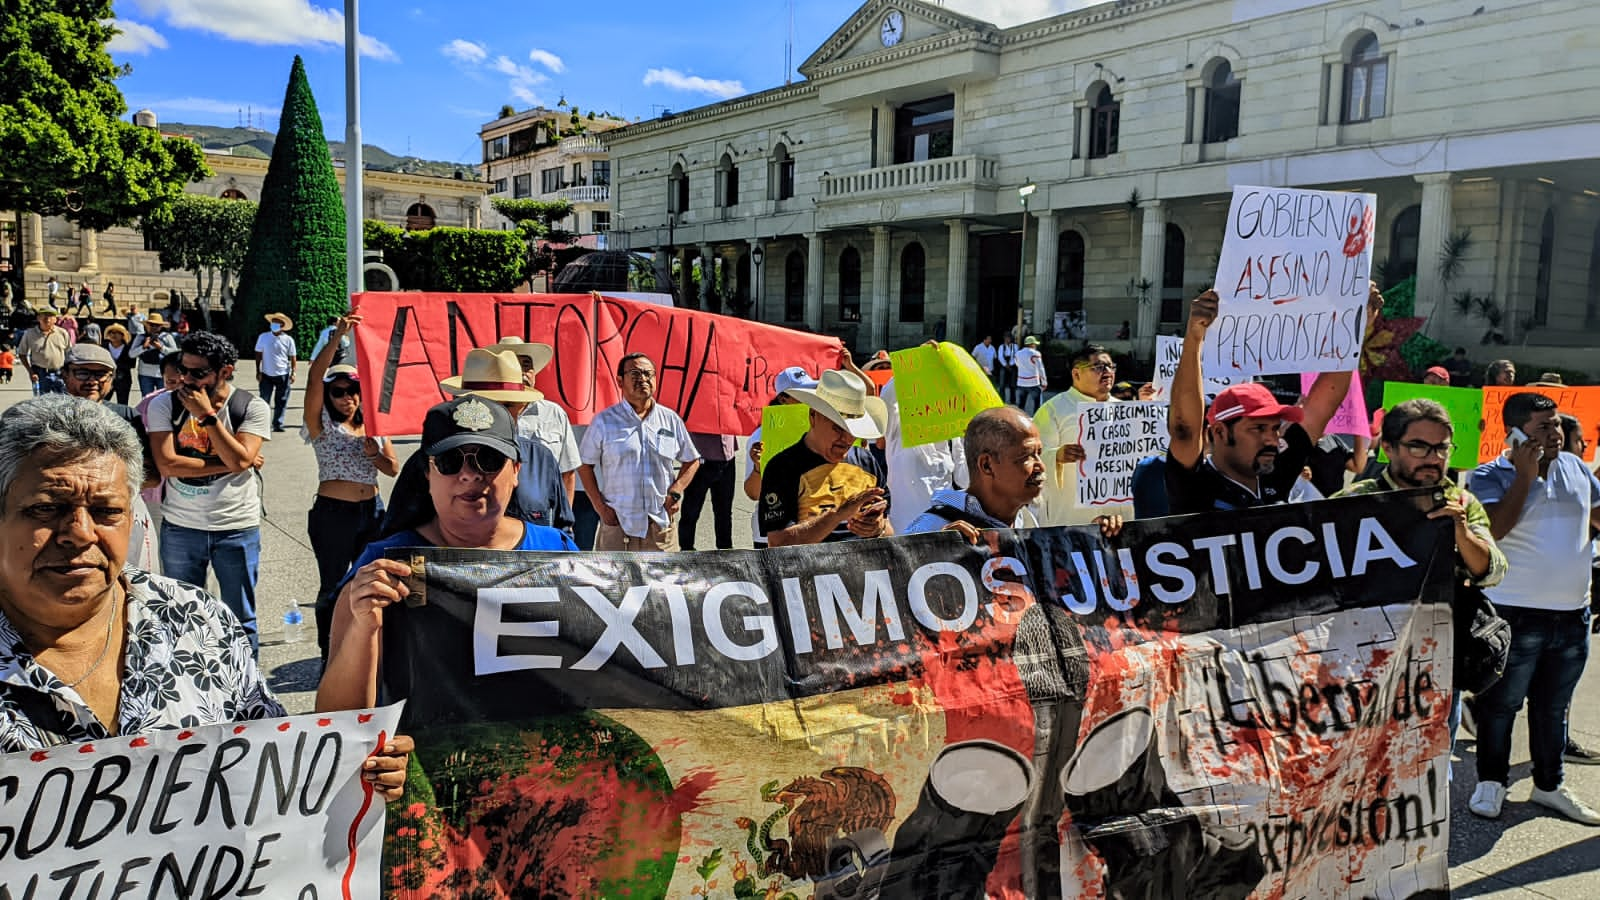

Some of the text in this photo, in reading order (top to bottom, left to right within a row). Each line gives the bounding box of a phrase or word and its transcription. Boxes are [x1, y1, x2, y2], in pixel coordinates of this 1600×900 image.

[1237, 191, 1364, 241] GOBIERNO
[1234, 250, 1367, 300] ASESINO DE
[1217, 304, 1364, 370] PERIODISTAS!
[1086, 404, 1170, 425] ESCLARECIMIENT
[1087, 420, 1157, 441] A CASOS DE
[1095, 457, 1140, 473] ASESIN
[1098, 436, 1166, 460] PERIODISTAS
[473, 517, 1417, 676] EXIGIMOS JUSTICIA
